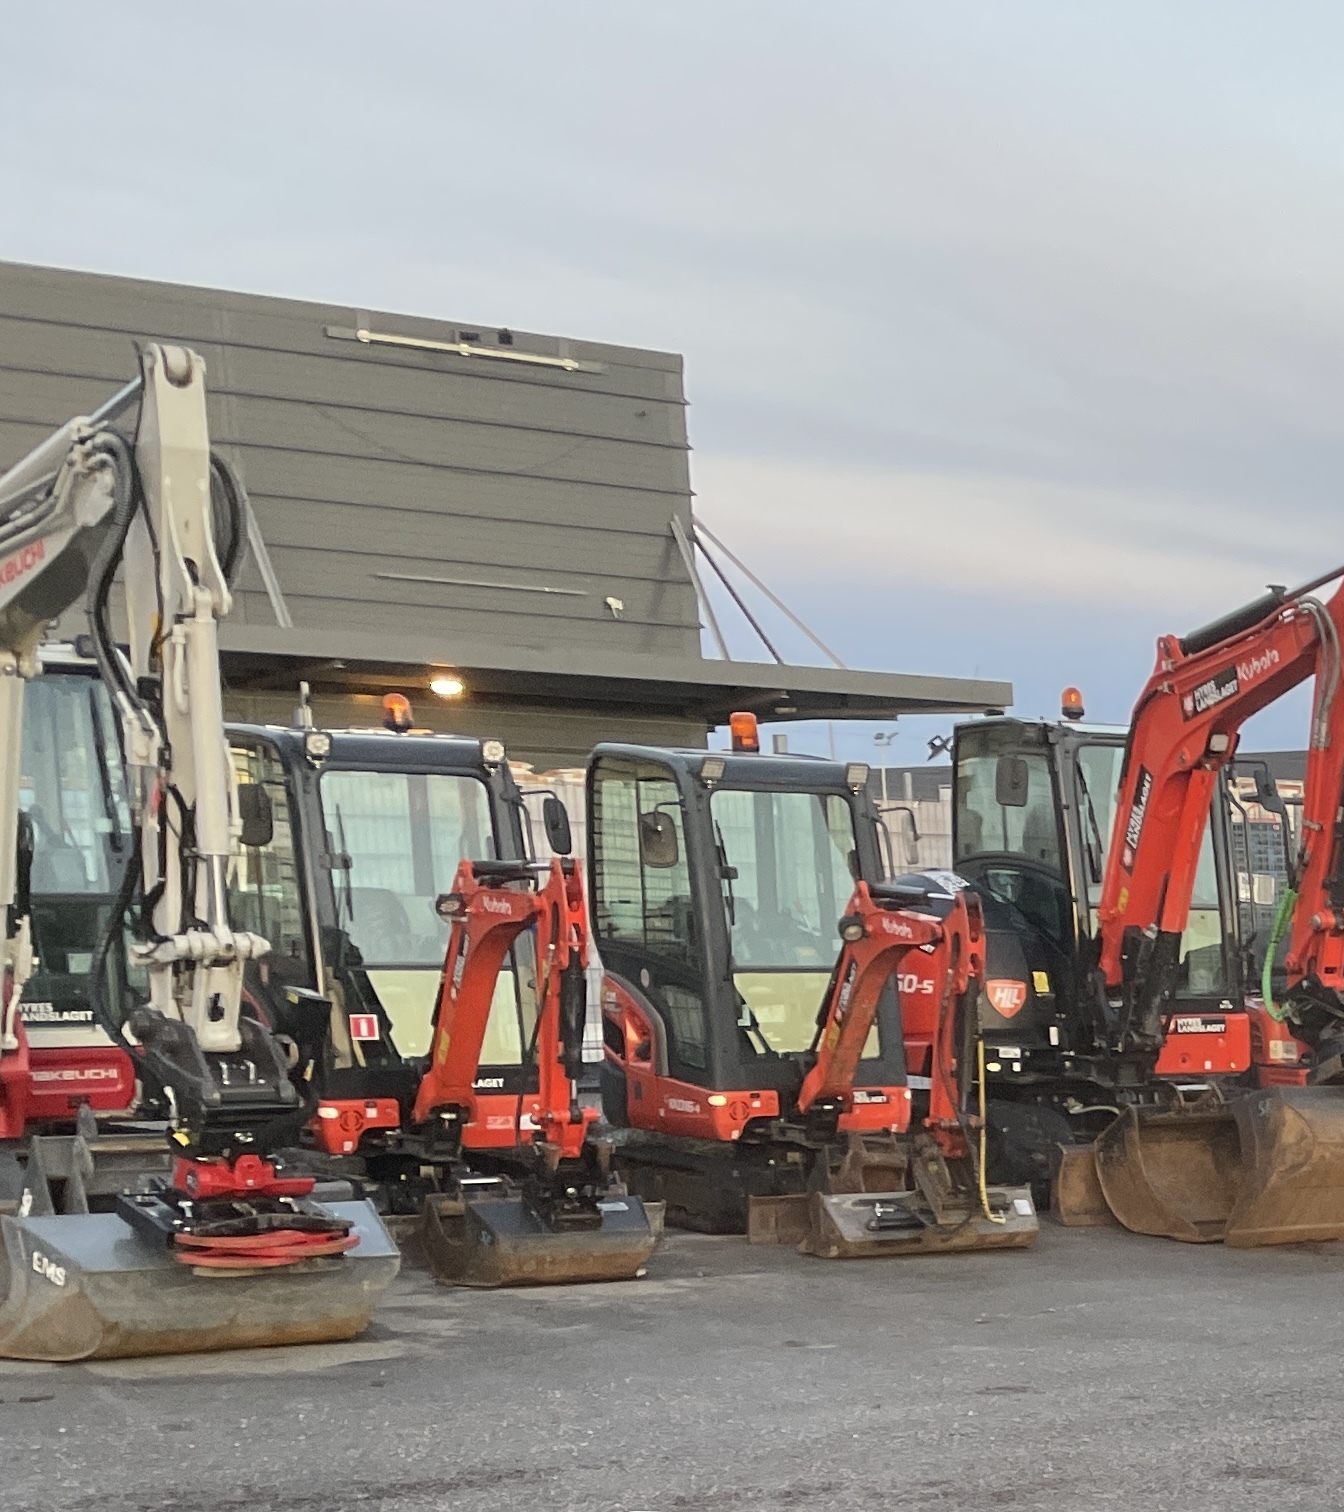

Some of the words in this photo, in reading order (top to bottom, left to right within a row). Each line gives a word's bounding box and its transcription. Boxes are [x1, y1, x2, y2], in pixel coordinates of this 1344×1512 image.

[20, 1002, 53, 1013] YRES
[20, 1010, 94, 1022] ANDSLAGET
[32, 1251, 67, 1288] EMS
